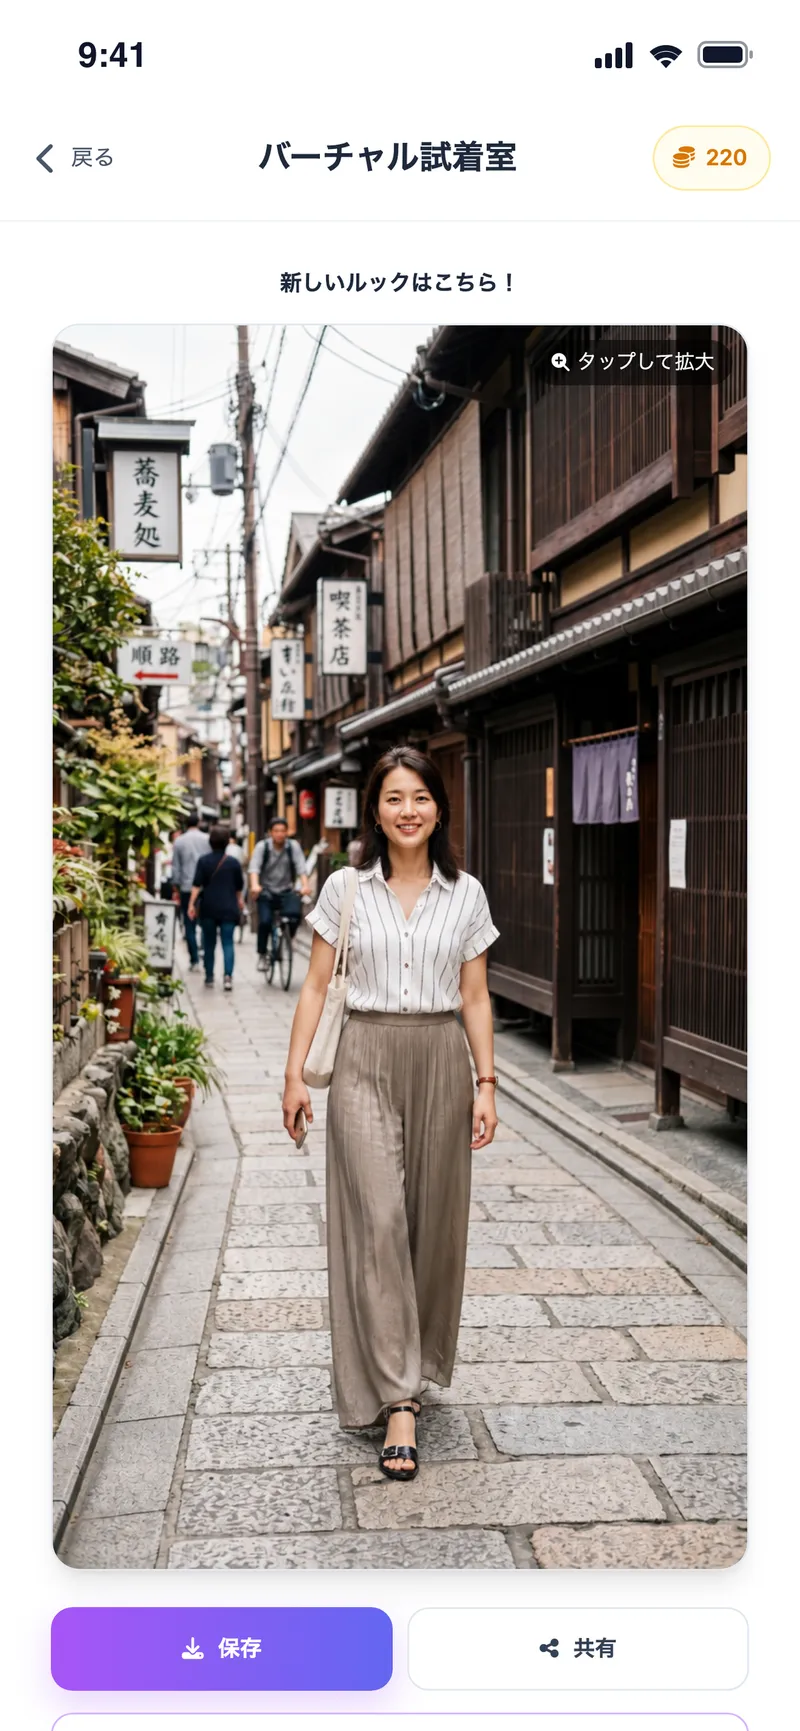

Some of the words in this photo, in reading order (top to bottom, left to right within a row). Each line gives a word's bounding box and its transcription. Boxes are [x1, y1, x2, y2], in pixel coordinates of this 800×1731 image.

[78, 41, 145, 69] 9:41
[71, 147, 114, 168] 戻る
[258, 140, 517, 172] バーチャル試着室
[706, 149, 748, 167] 220
[279, 271, 514, 294] 新しいルックはこちら！
[133, 456, 161, 549] 蕎麦処
[329, 588, 352, 666] 喫茶店
[131, 644, 181, 666] 順路
[217, 1636, 262, 1659] 保存
[573, 1636, 617, 1659] 共有
